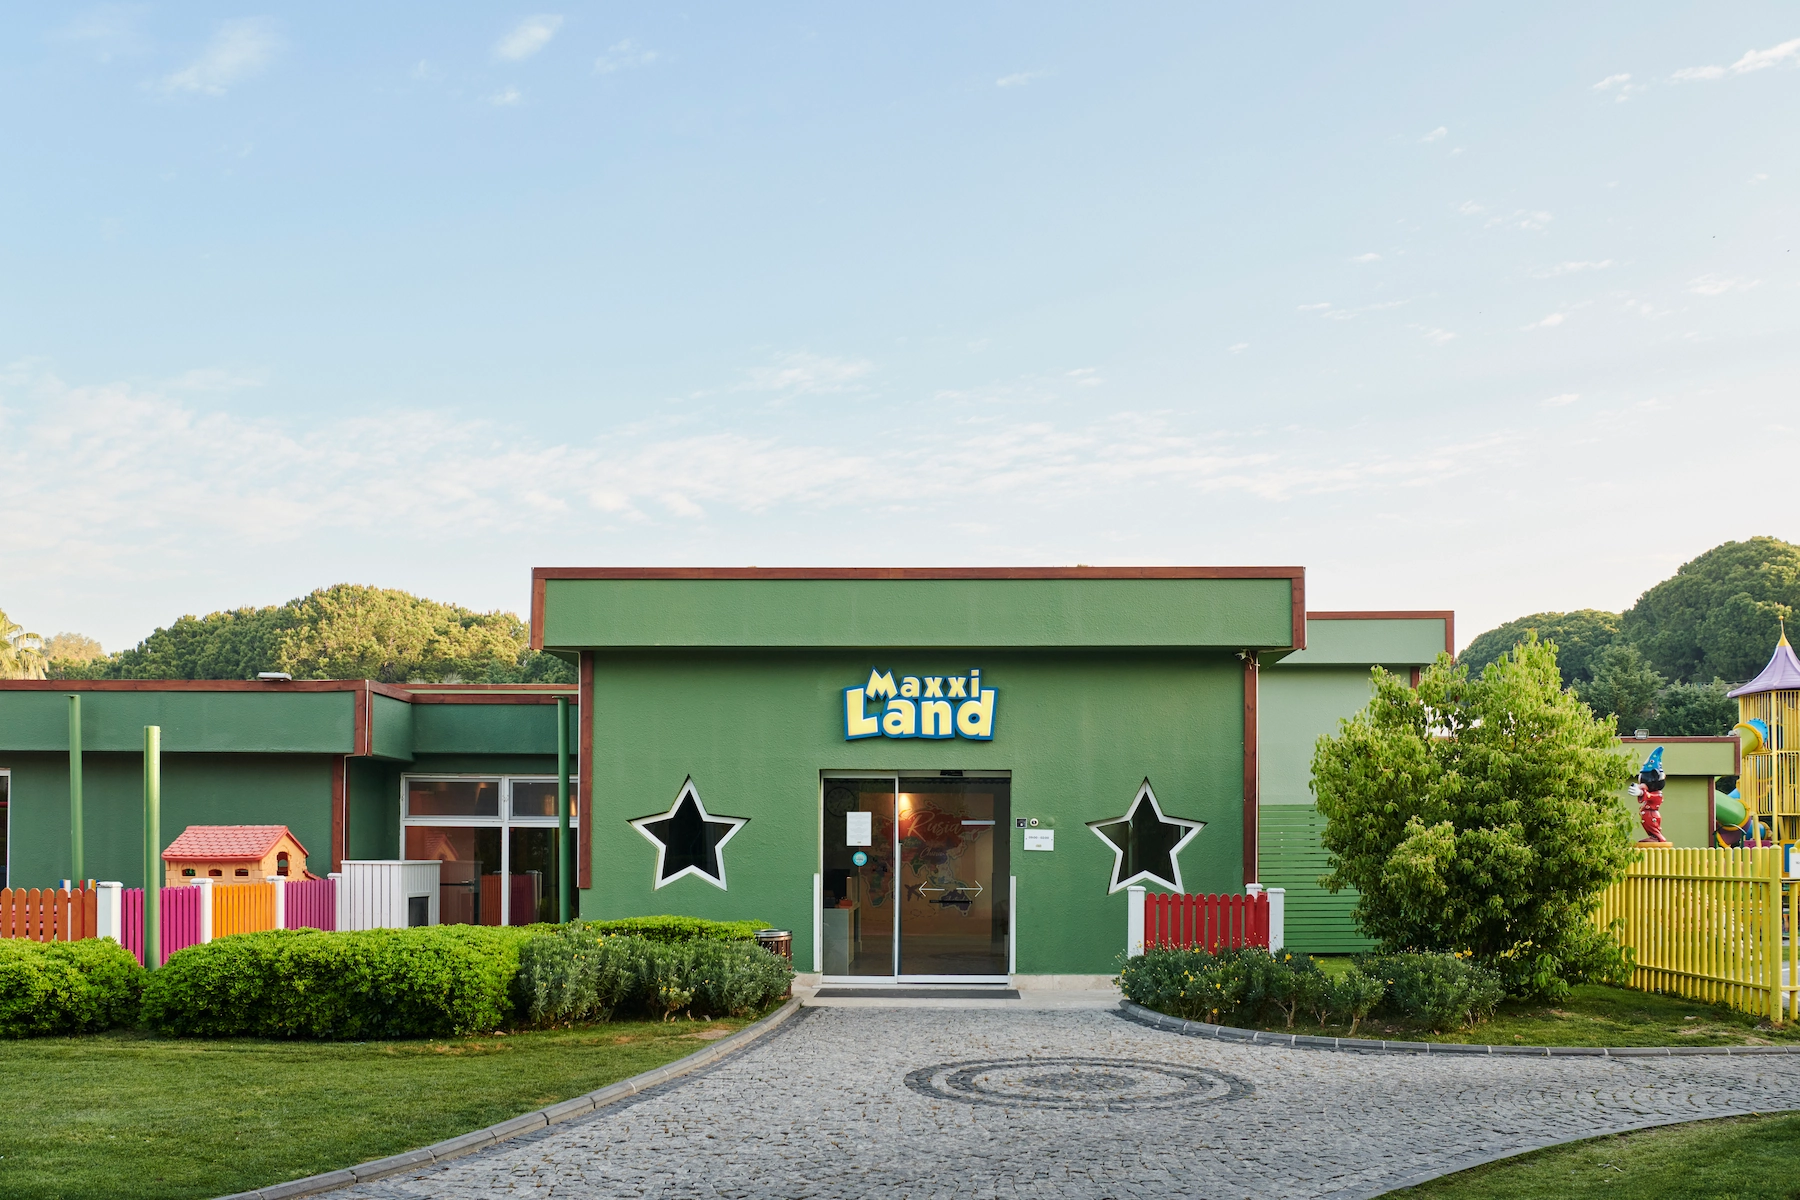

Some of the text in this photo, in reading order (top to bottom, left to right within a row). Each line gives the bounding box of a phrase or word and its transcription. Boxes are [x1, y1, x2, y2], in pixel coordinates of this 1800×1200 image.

[865, 668, 980, 700] Maxxi
[846, 687, 995, 737] Land
[903, 810, 962, 842] Rusia
